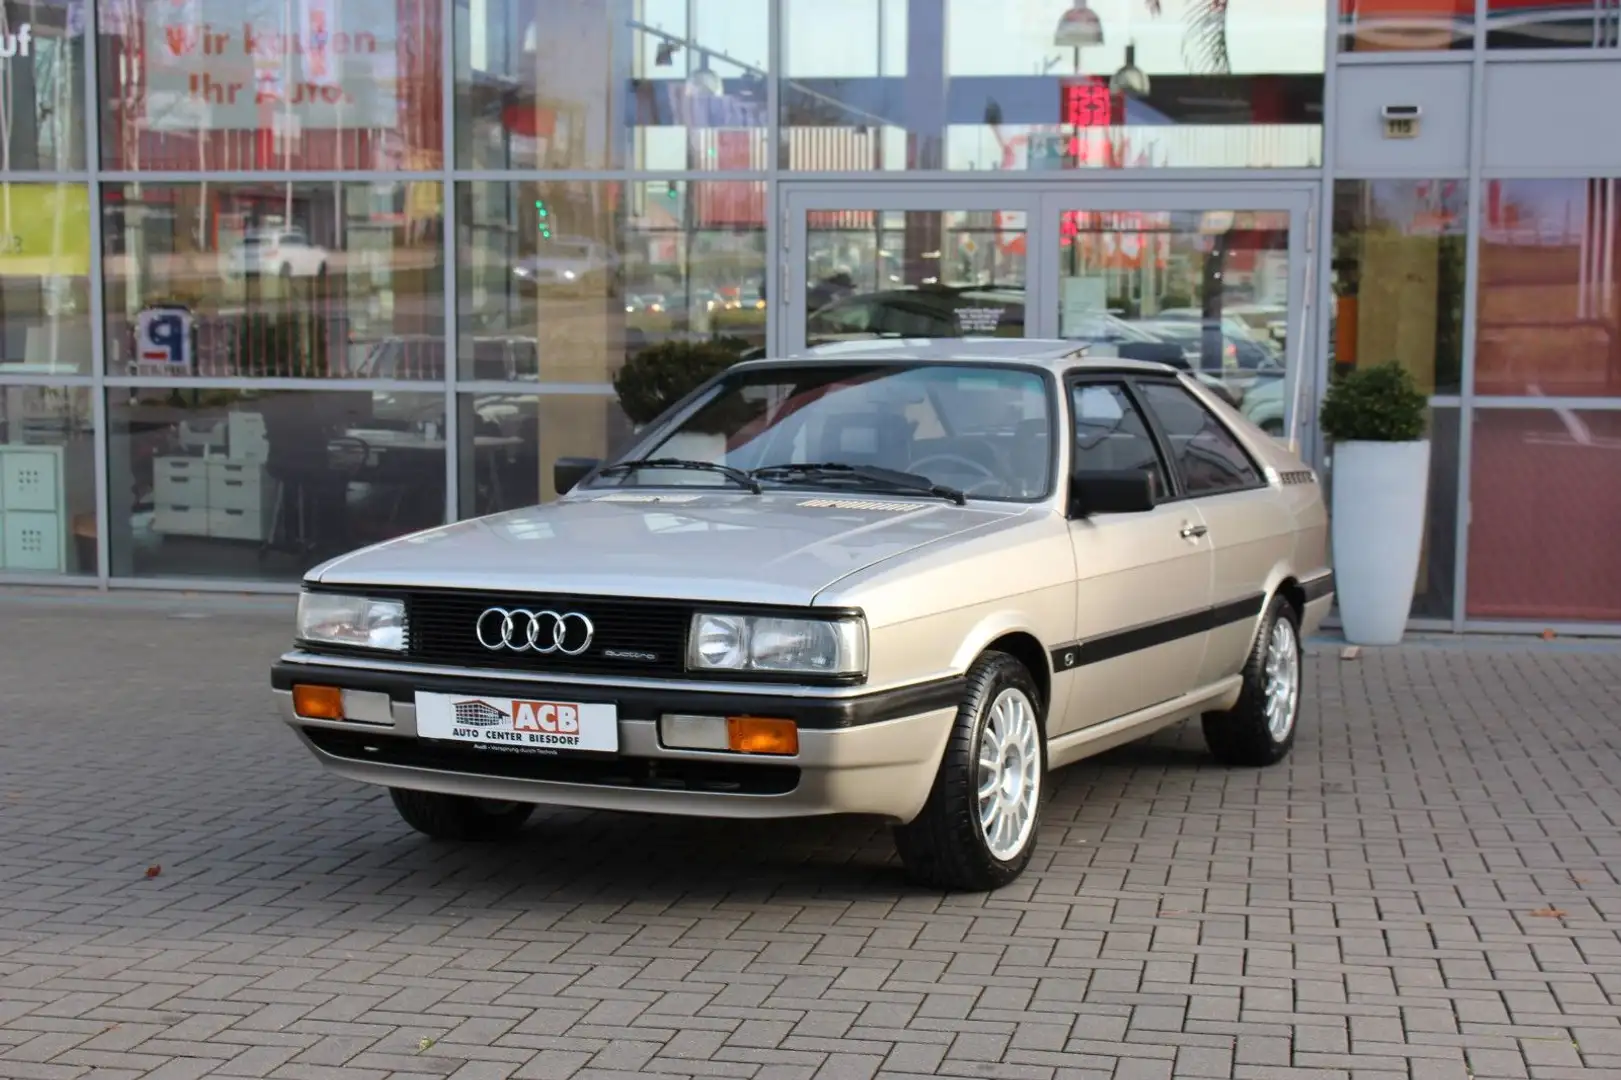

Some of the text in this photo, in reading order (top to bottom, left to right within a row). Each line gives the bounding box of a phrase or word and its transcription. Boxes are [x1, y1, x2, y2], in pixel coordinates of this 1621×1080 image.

[165, 21, 377, 56] Wir kauen
[189, 71, 243, 105] Ihr
[515, 702, 578, 733] ACB
[453, 727, 580, 747] AUTO CENTER BIESDORF
